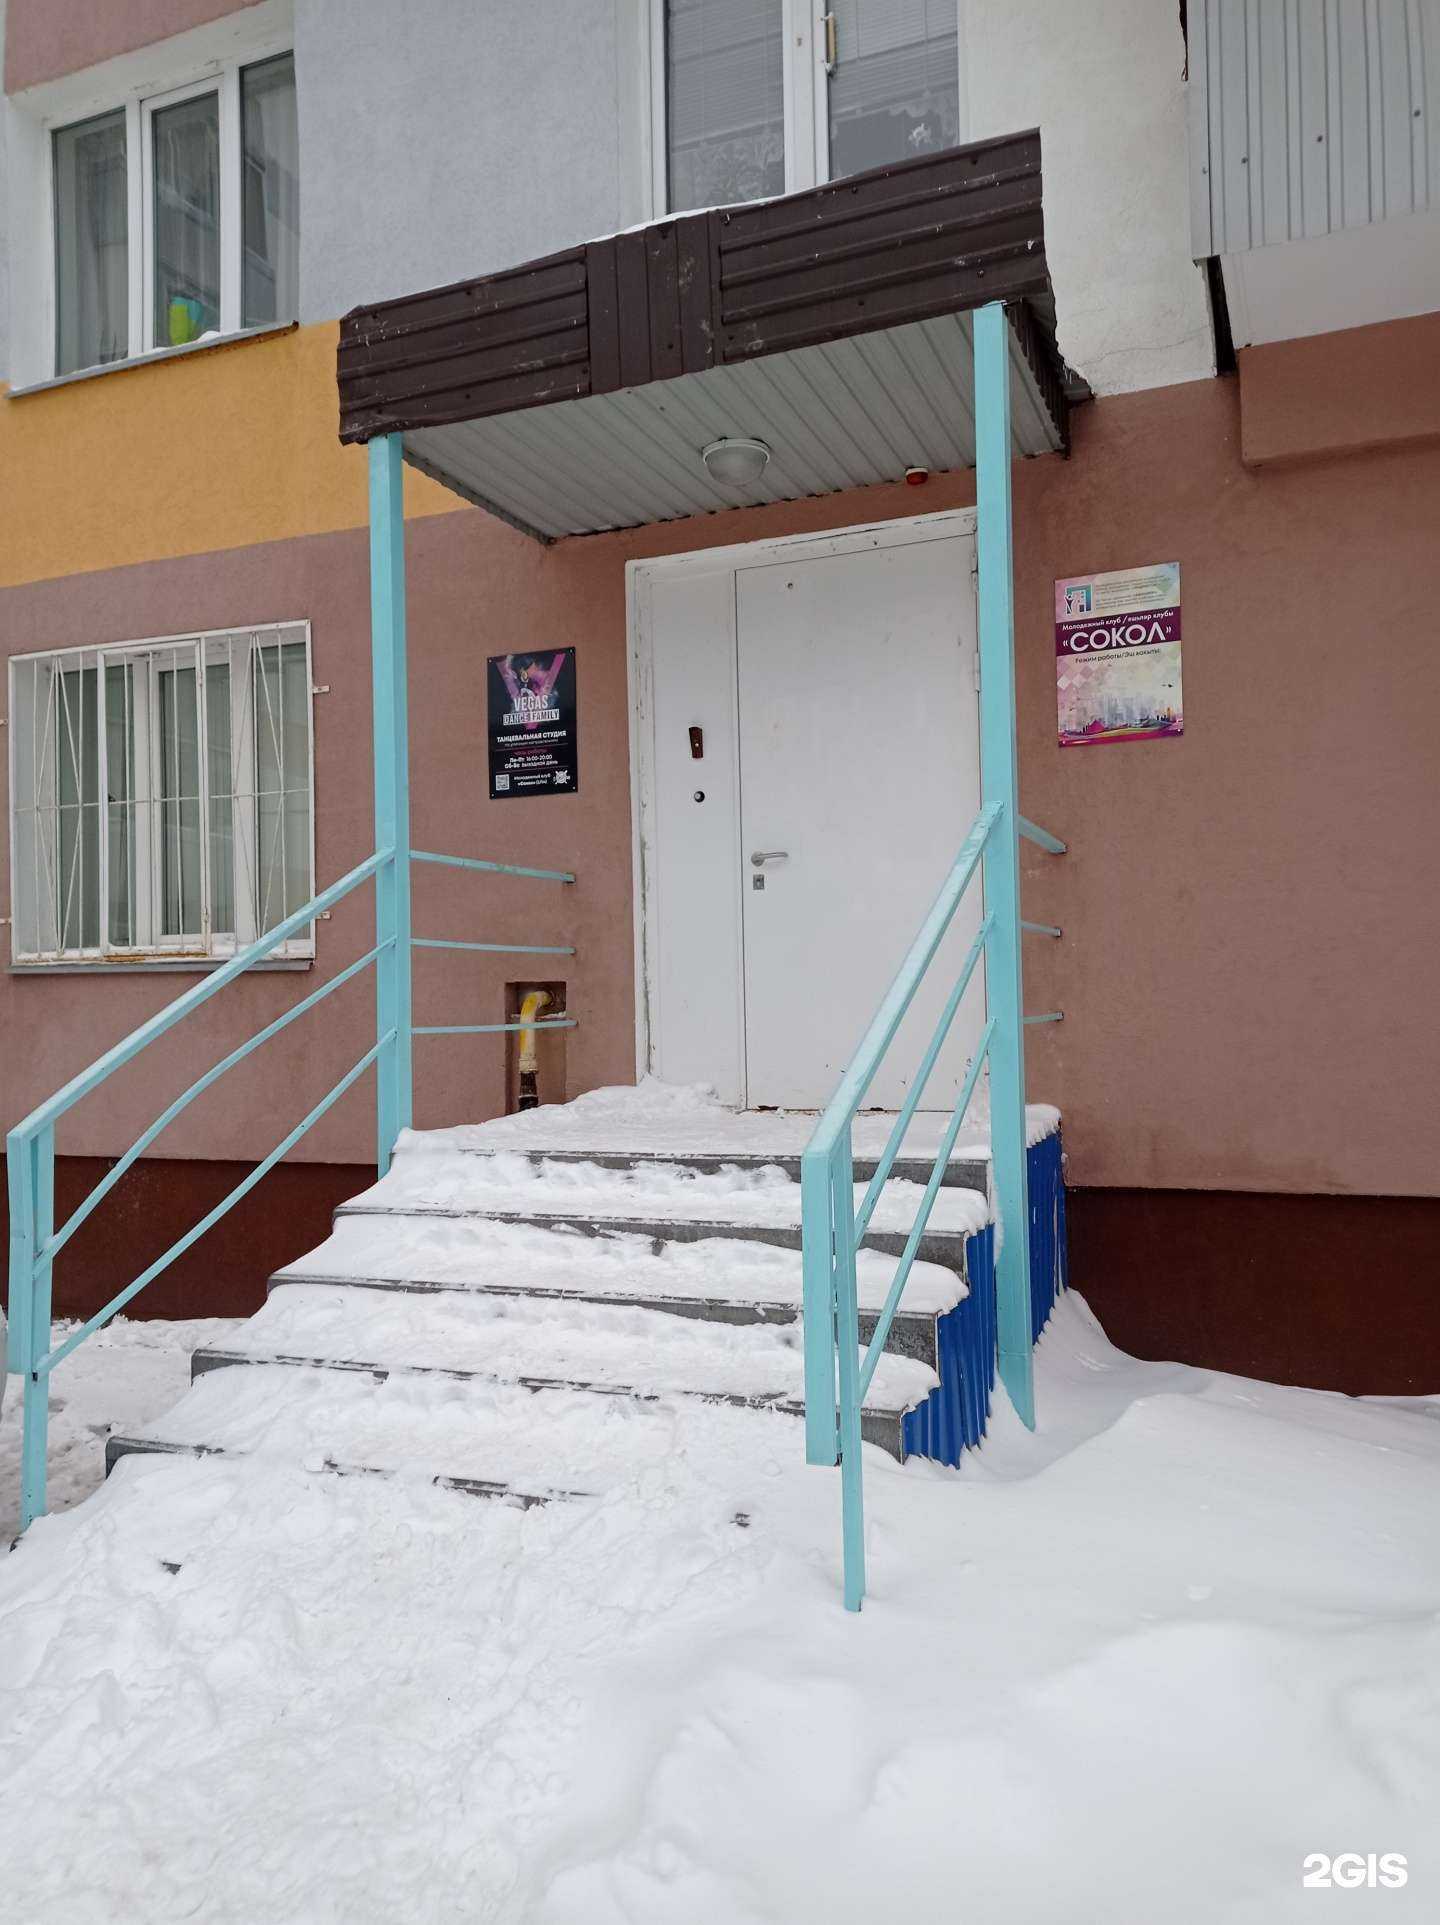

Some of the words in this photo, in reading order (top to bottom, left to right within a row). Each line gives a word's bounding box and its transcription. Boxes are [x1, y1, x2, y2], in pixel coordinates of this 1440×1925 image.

[1105, 616, 1121, 626] клуб
[1153, 609, 1174, 619] клубы
[1062, 621, 1172, 652] «СОКОЛ»
[513, 694, 549, 711] VEGAS
[504, 712, 530, 725] DANCE
[532, 709, 559, 722] FAMILY
[497, 732, 542, 743] ТАНЦЕВАЛЬНАЯ
[542, 730, 567, 738] СТУДИЯ
